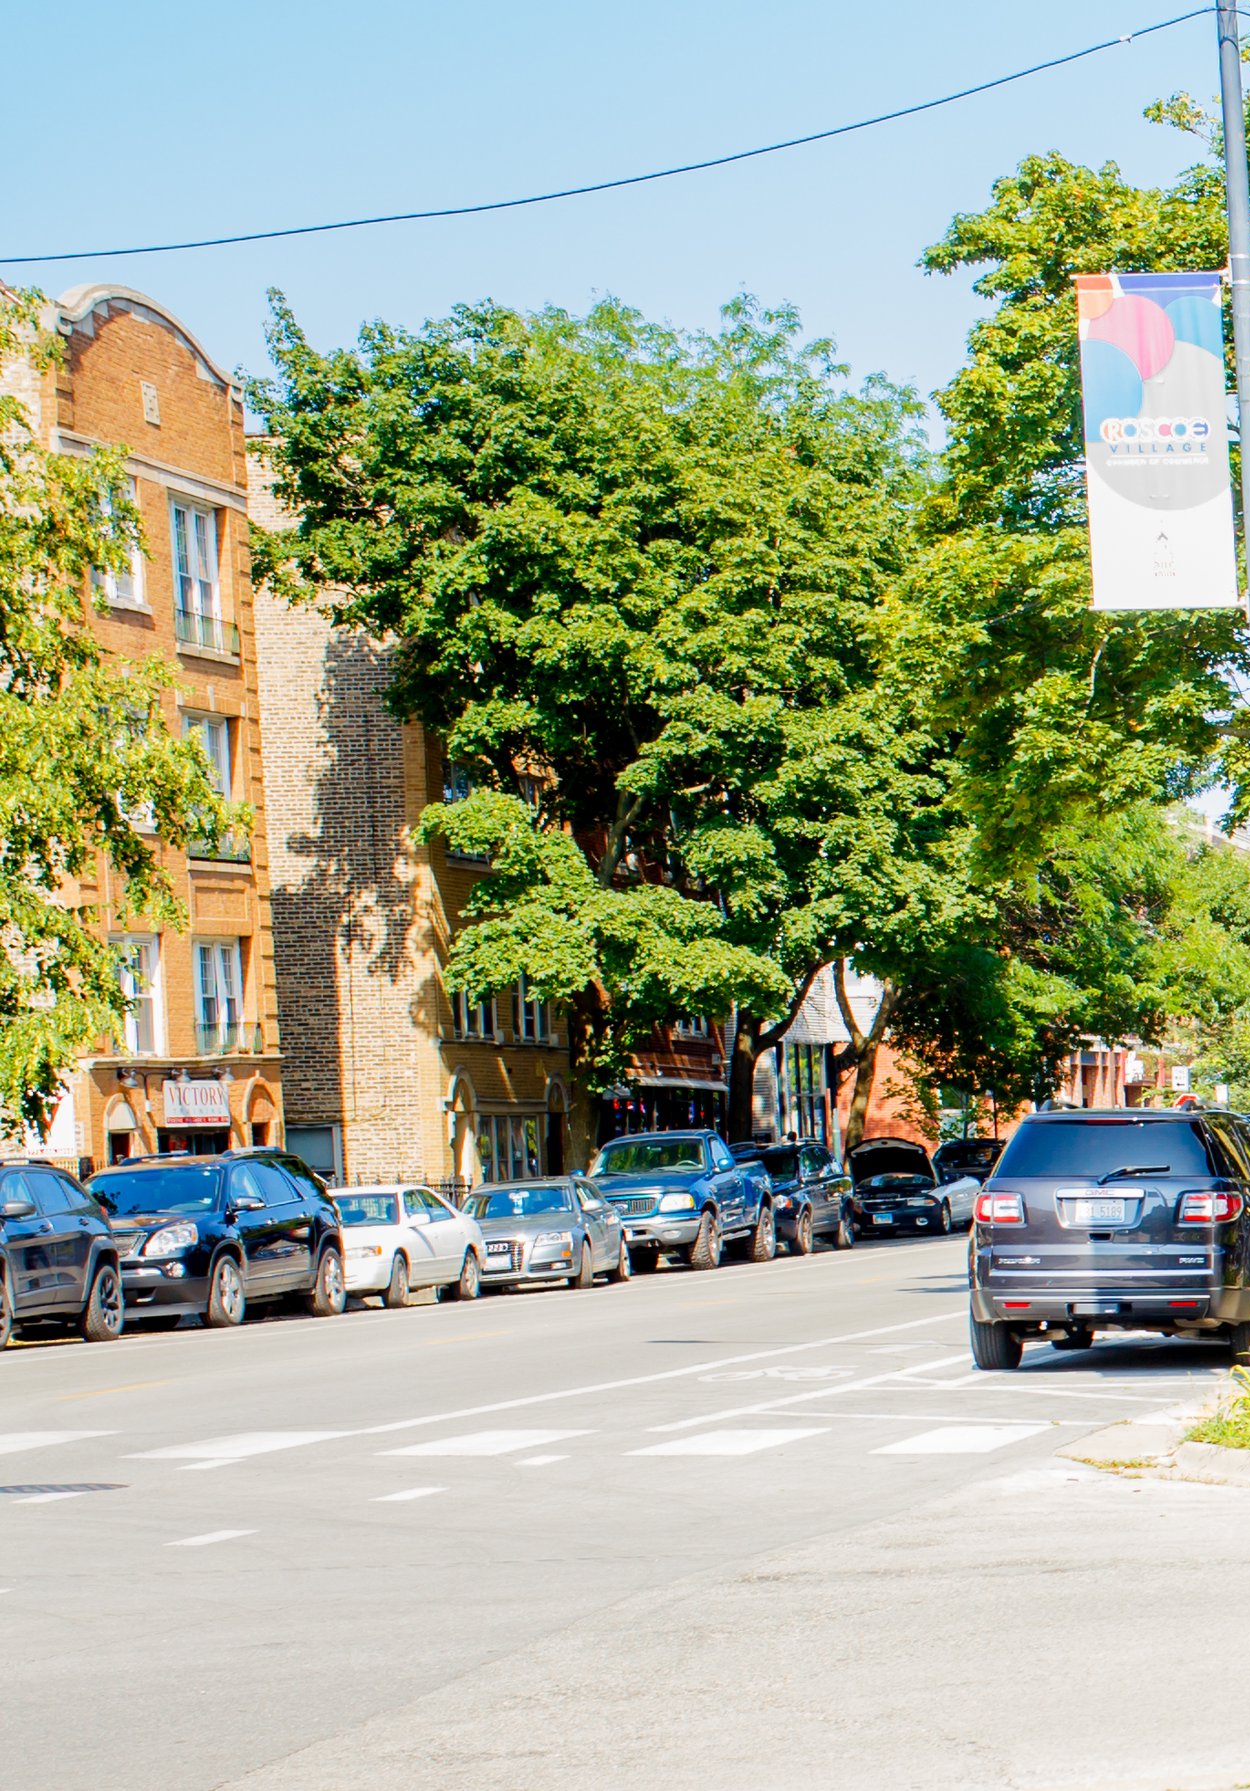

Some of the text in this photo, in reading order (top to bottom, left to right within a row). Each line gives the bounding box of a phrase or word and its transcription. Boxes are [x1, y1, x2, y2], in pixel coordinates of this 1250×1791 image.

[1100, 418, 1210, 442] ROSCOE
[1109, 443, 1207, 454] VILLAGE
[168, 1087, 225, 1106] VICTORY
[1100, 1206, 1122, 1218] 5189
